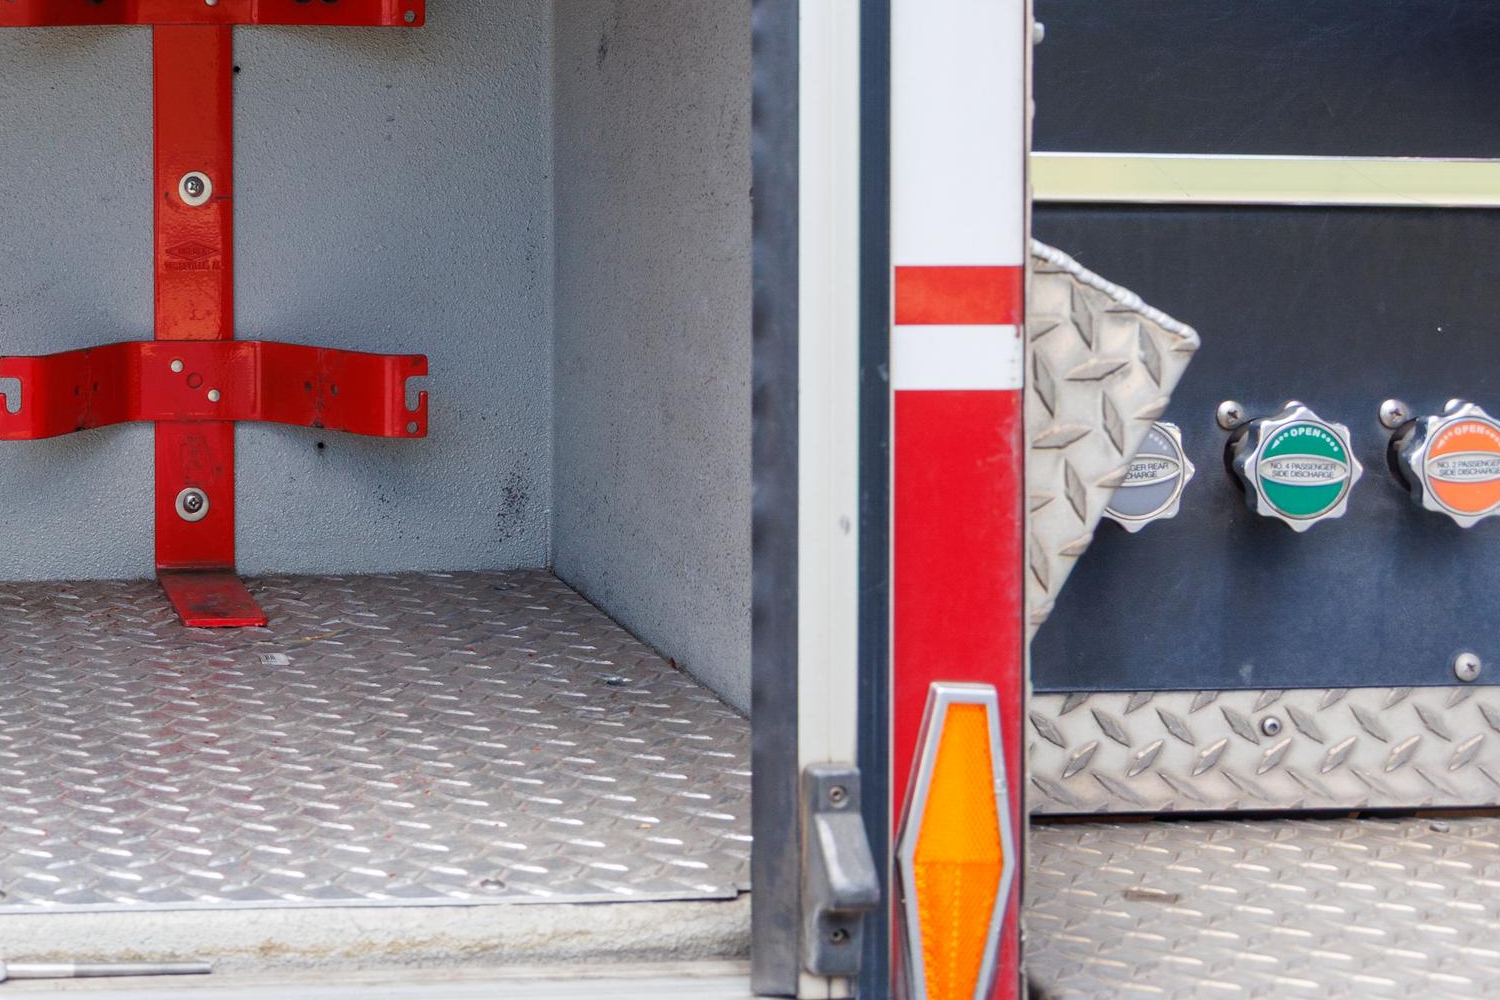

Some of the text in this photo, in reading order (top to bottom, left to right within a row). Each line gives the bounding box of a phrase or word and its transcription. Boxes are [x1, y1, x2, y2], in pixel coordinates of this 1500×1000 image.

[1290, 427, 1321, 437] OPEN
[1454, 425, 1485, 435] OPEN
[1291, 462, 1336, 470] PASSENGER
